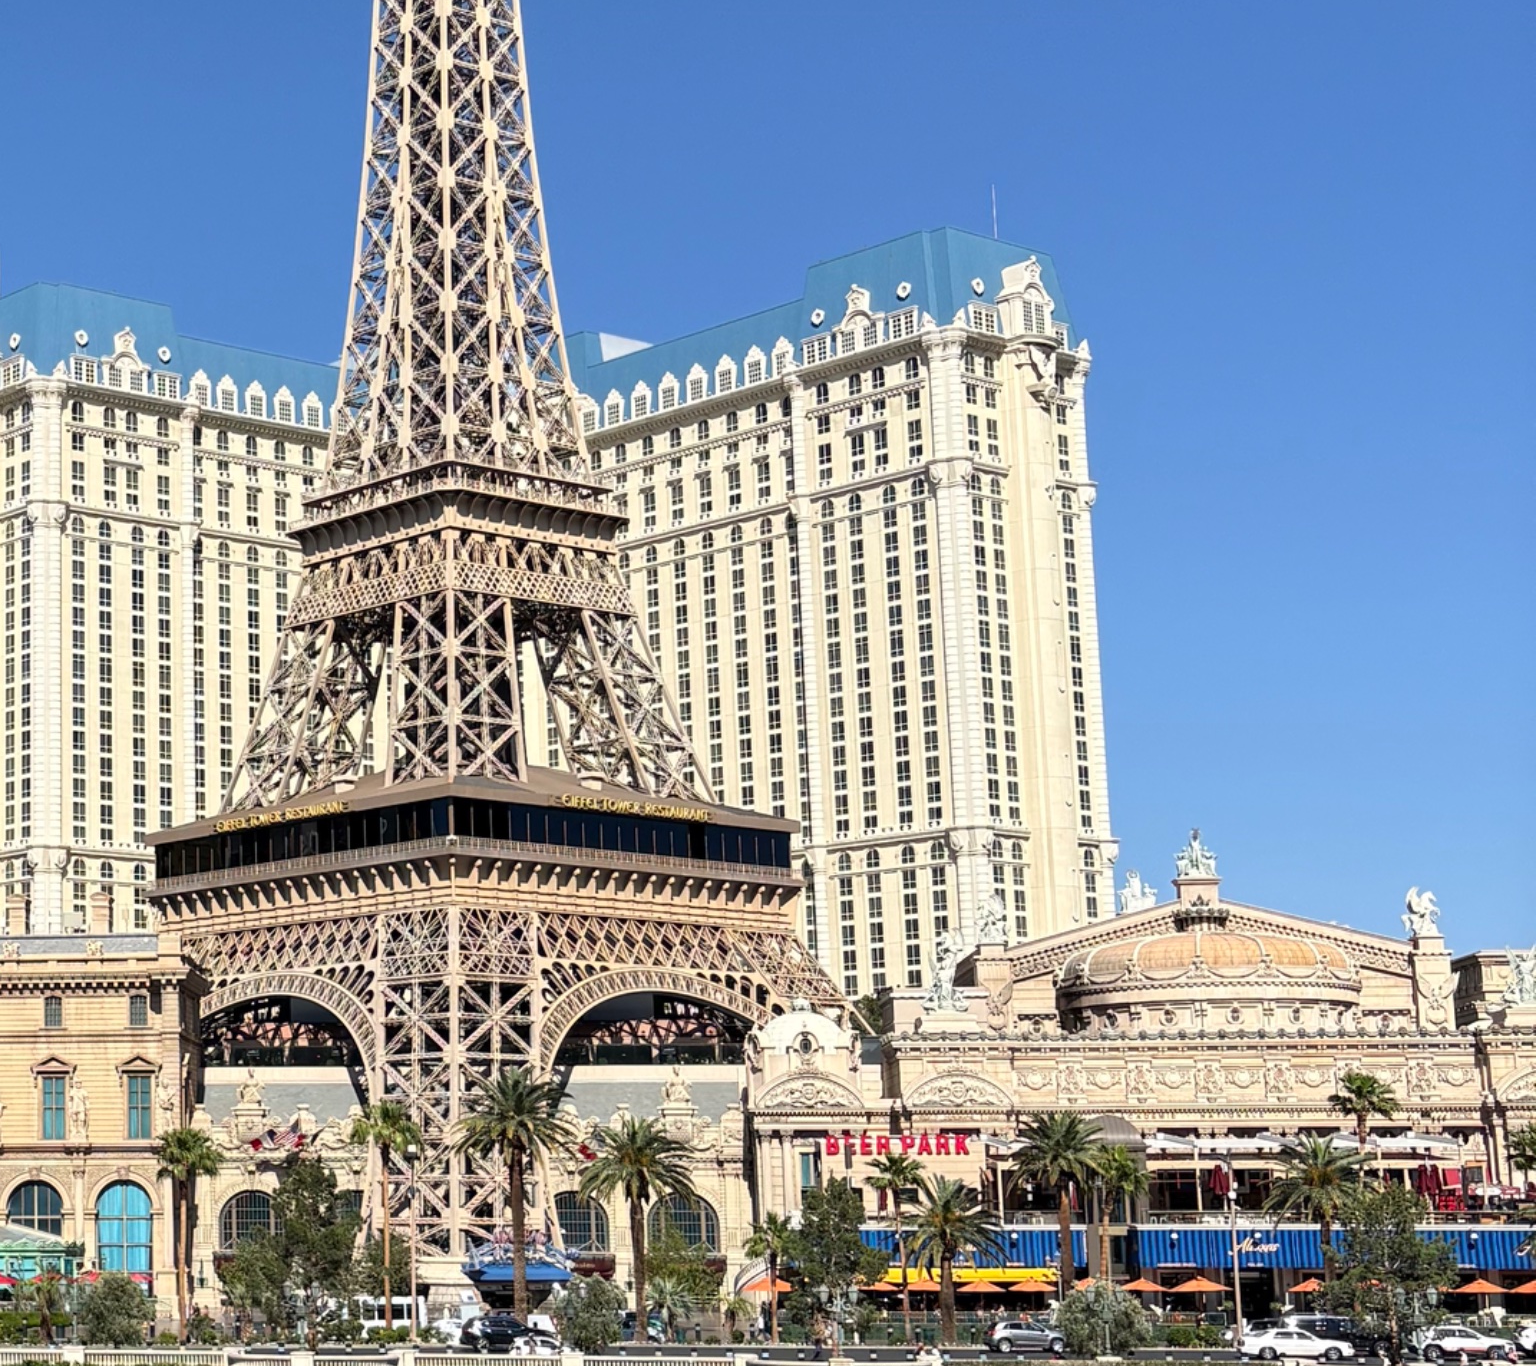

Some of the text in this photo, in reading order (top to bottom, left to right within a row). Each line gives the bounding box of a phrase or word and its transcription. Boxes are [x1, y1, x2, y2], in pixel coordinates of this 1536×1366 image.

[249, 811, 281, 828] TOWER
[284, 800, 344, 821] RESTAURANT
[562, 793, 710, 821] EIFFEL TOWER RESTAURANT
[826, 1133, 970, 1156] BEER PARK
